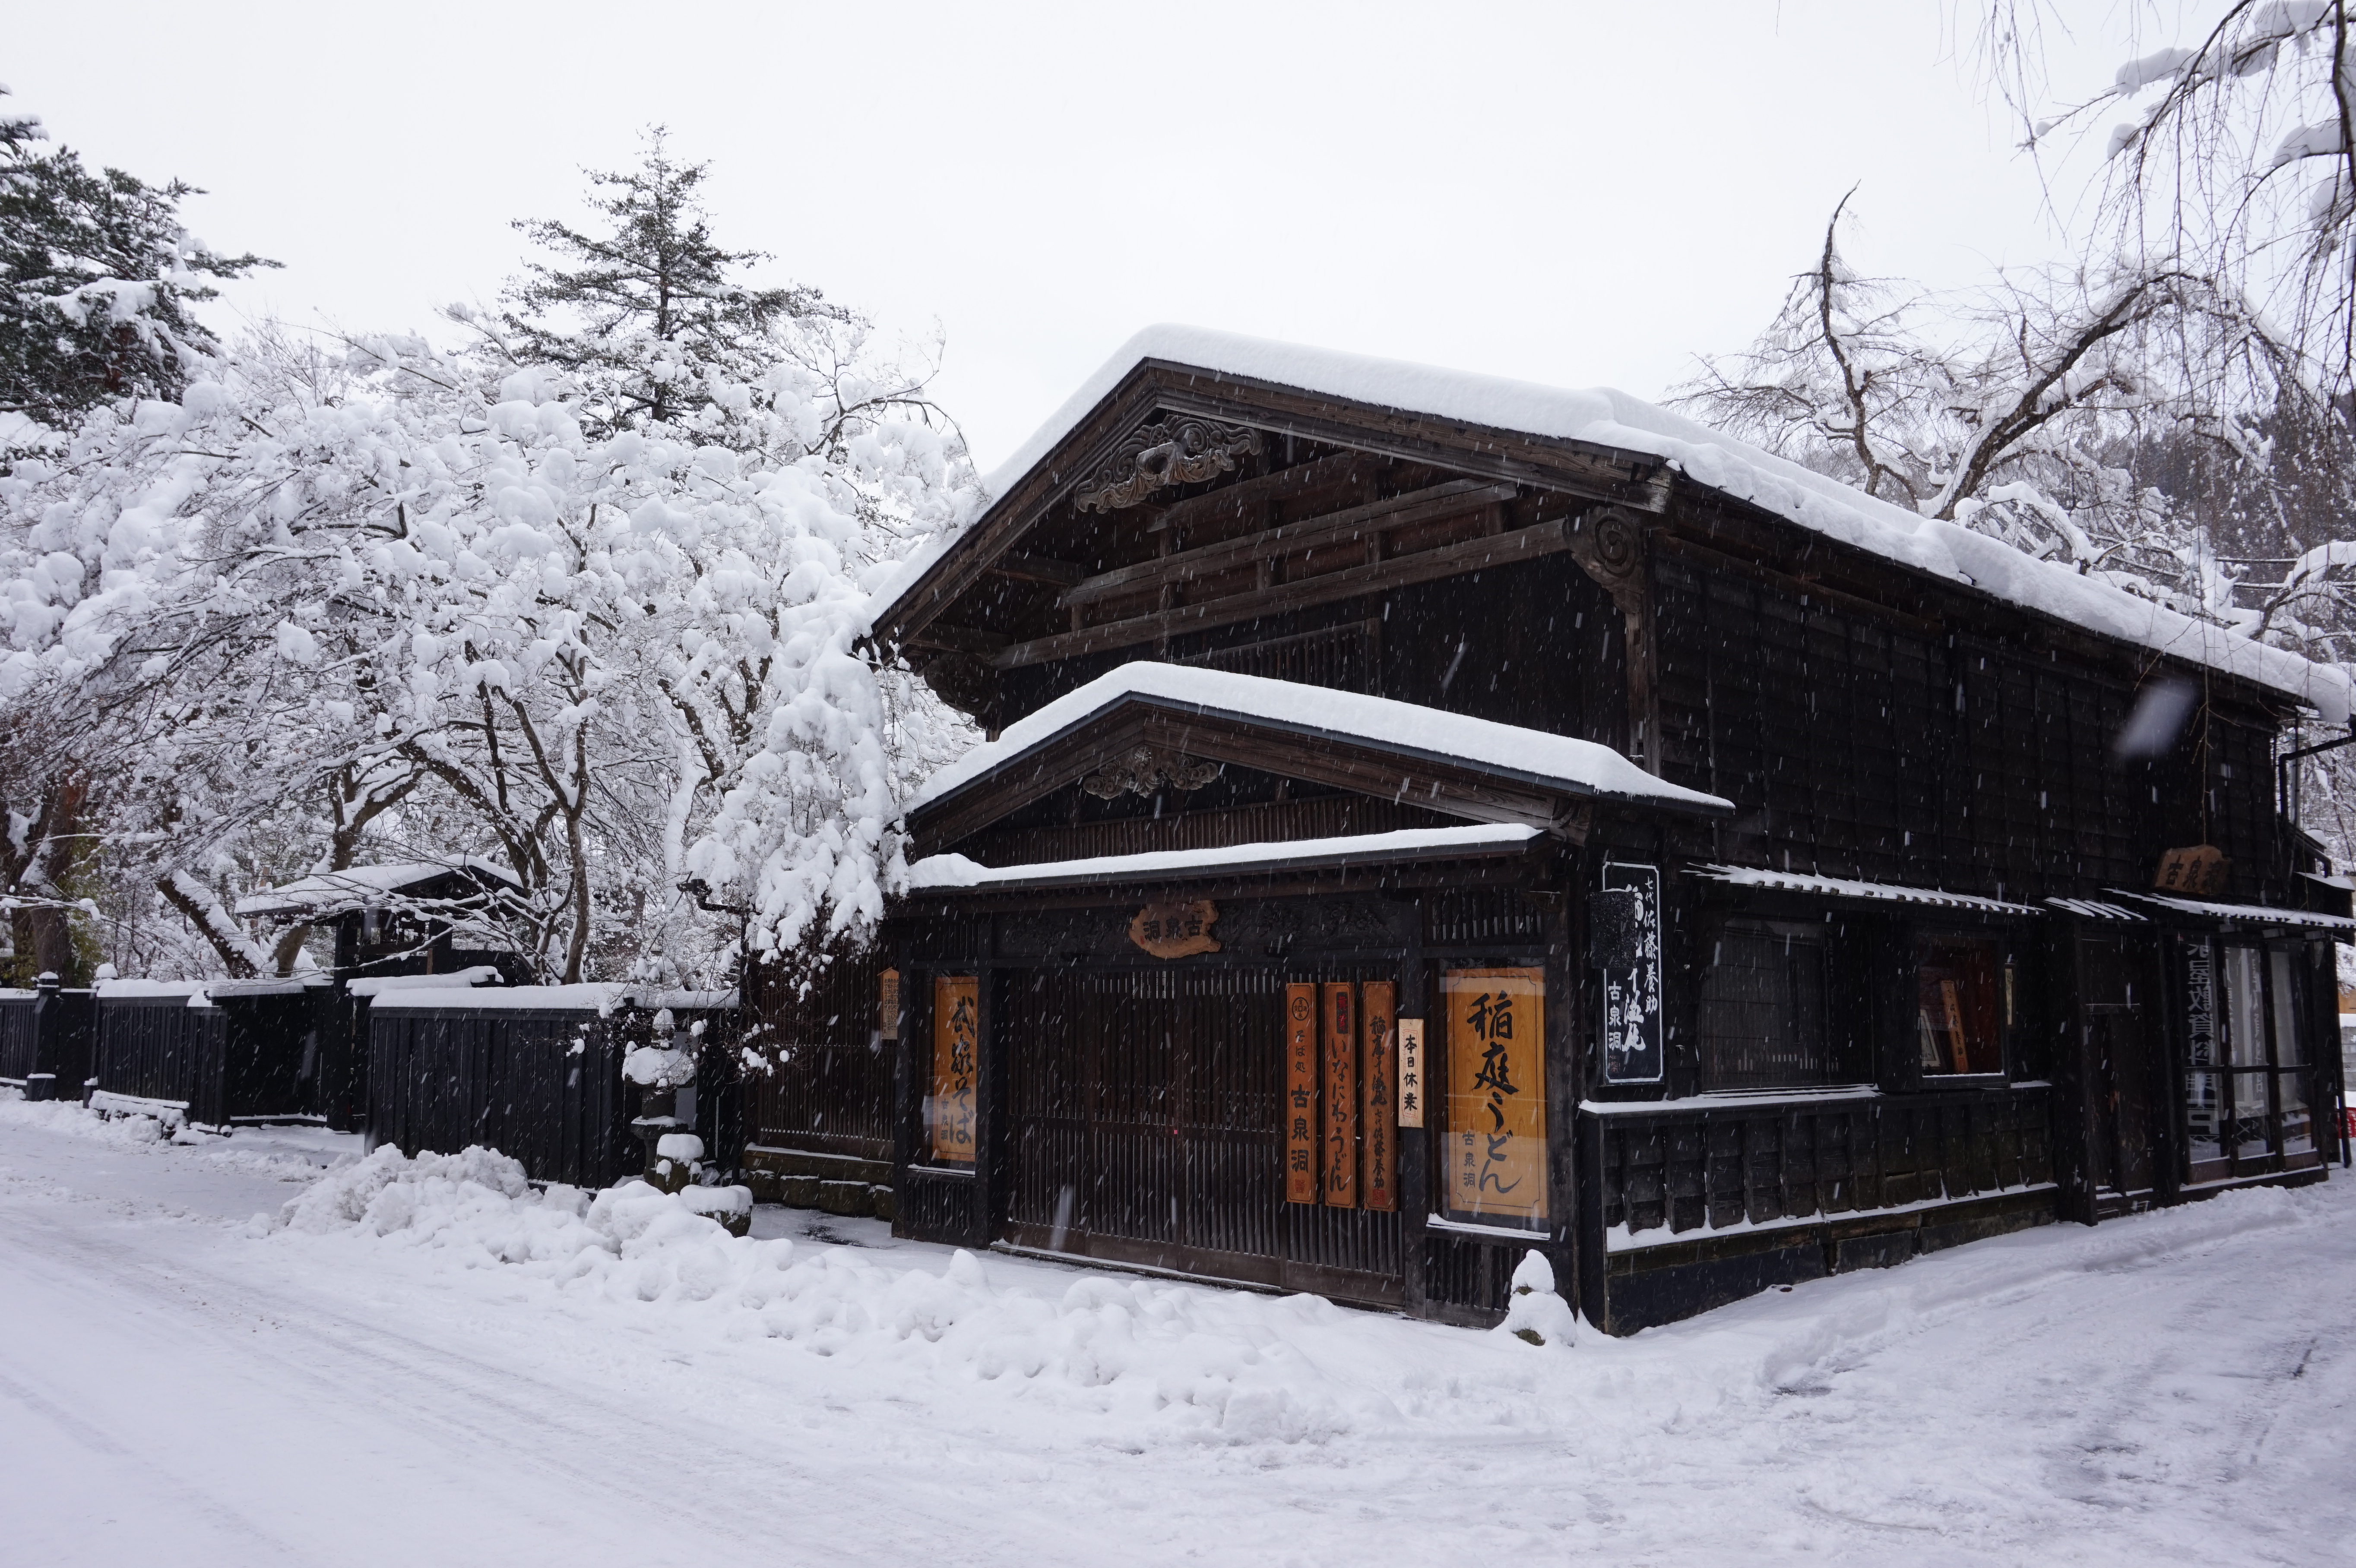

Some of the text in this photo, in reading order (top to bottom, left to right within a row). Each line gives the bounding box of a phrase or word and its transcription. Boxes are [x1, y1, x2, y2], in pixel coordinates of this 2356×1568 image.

[1143, 915, 1203, 942] 古泉洞
[1608, 980, 1622, 1051] 古泉洞
[950, 996, 975, 1145] 武家そば
[1403, 1034, 1418, 1111] 本日休業
[1467, 990, 1522, 1194] 稲庭うどん
[1290, 1083, 1310, 1173] 古泉洞
[1331, 1037, 1352, 1192] いなにわうどん
[1462, 1130, 1476, 1188] 古泉洞
